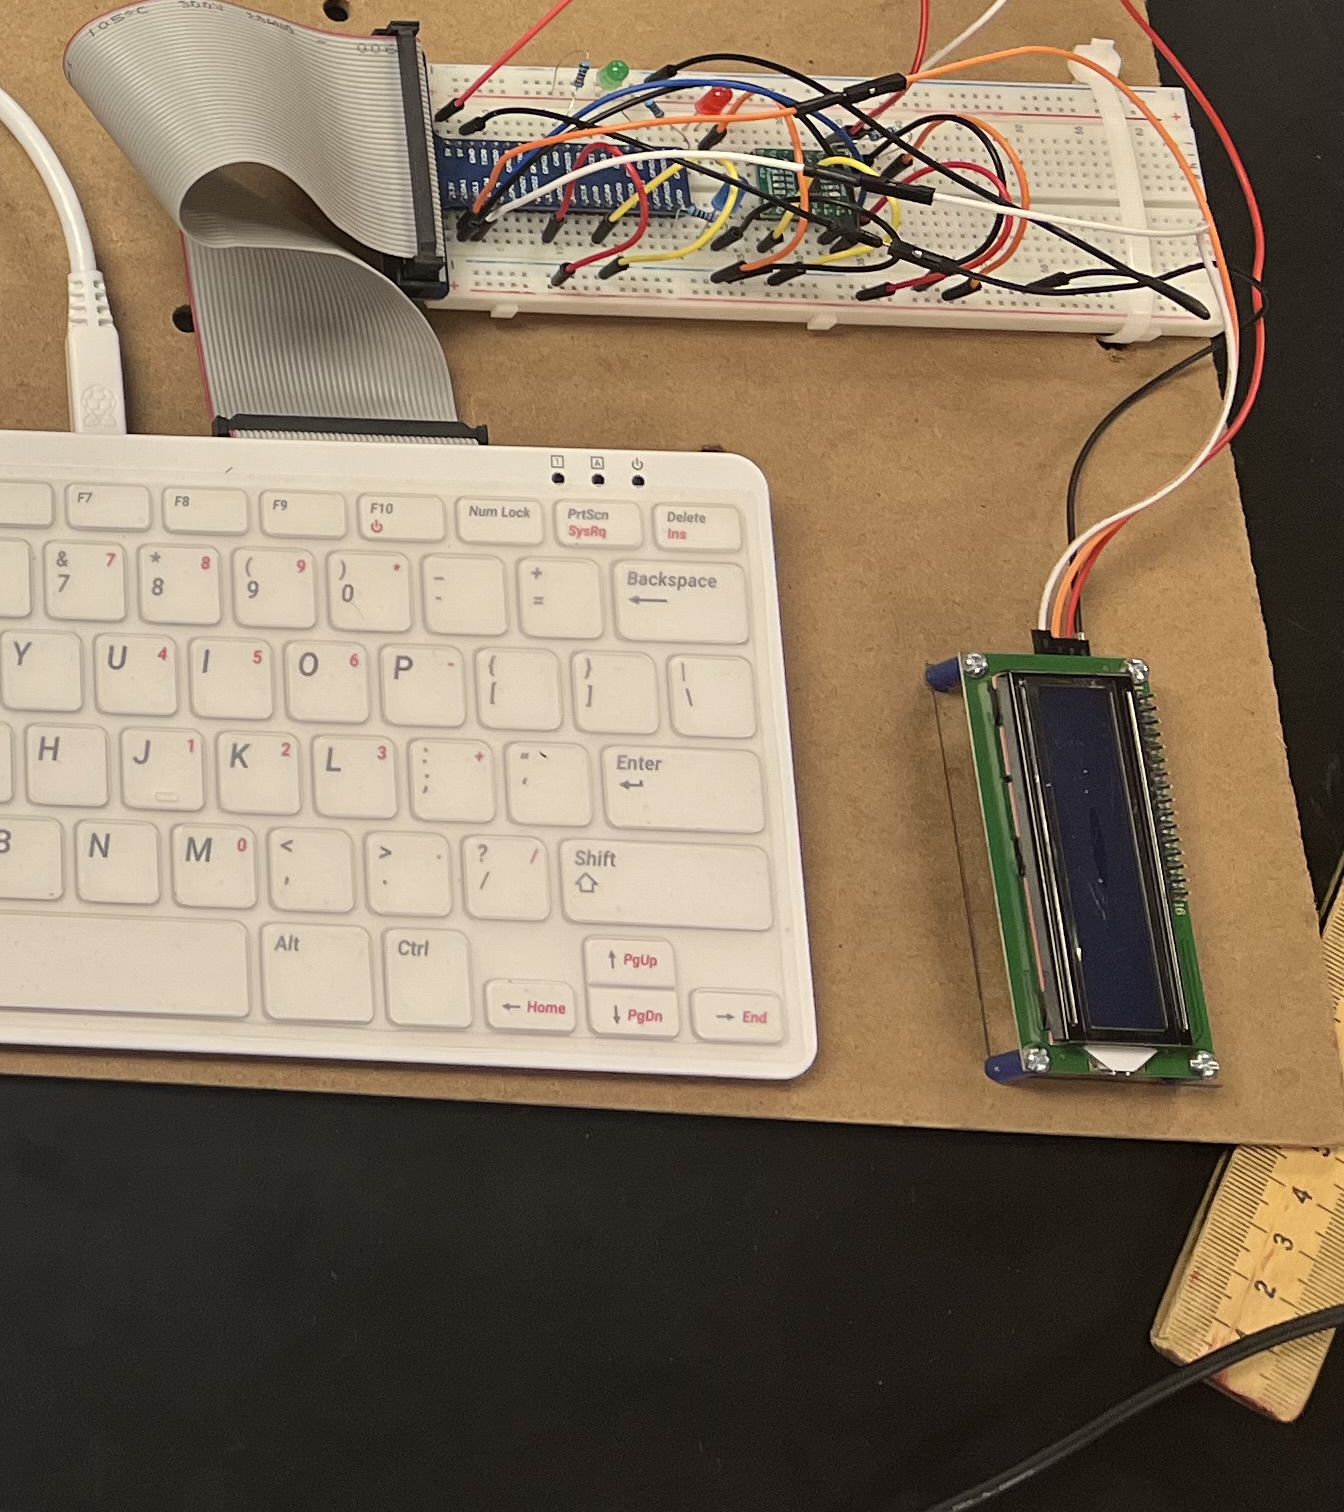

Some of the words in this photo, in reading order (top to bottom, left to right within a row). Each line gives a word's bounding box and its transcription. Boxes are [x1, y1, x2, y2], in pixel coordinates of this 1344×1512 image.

[77, 491, 93, 504] F7
[174, 495, 190, 507] F8
[272, 499, 288, 511] F9
[370, 502, 394, 515] F10
[468, 505, 498, 517] Num
[501, 506, 531, 519] Lock
[567, 508, 609, 521] PrtScn
[666, 511, 706, 524] Delete
[568, 524, 607, 539] SysRq
[667, 527, 687, 540] Ins
[627, 570, 718, 591] Backspace
[615, 754, 663, 771] Enter
[574, 849, 617, 868] Shift
[273, 934, 300, 952] Alt
[397, 939, 430, 957] Ctrl
[623, 953, 658, 969] PgUp
[527, 1000, 566, 1015] Home
[627, 1008, 663, 1025] PgDn
[742, 1010, 768, 1024] End
[1292, 1186, 1313, 1204] 4
[1273, 1233, 1294, 1251] 3
[1254, 1280, 1276, 1299] 2
